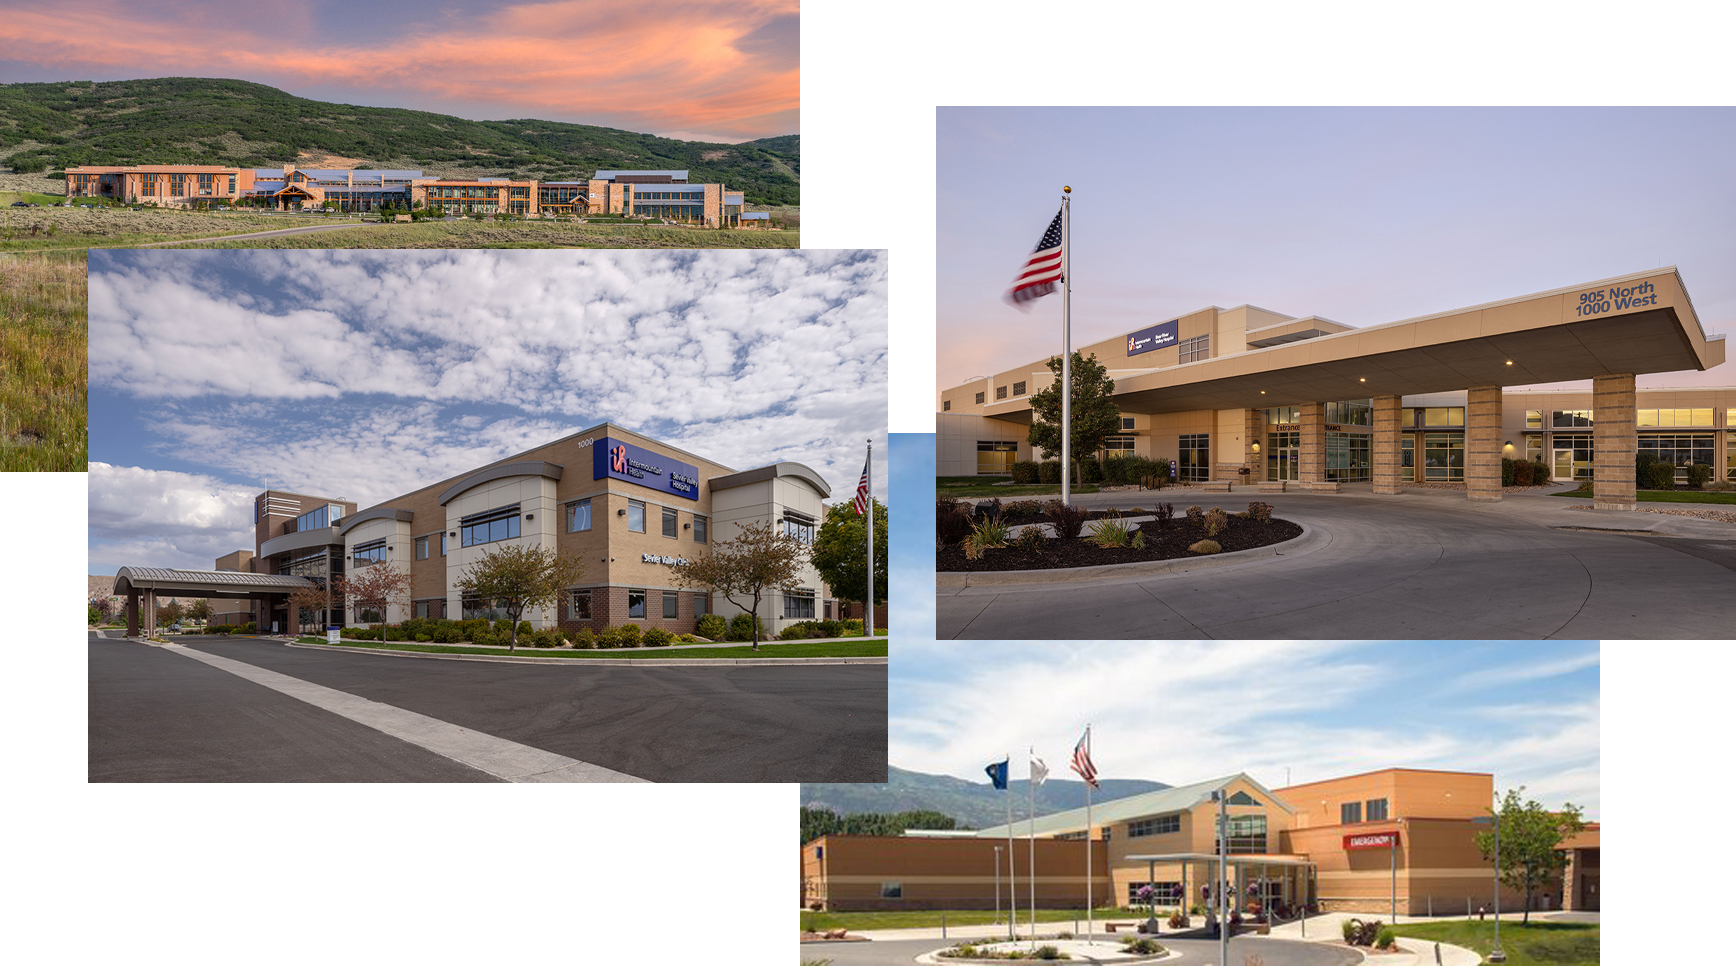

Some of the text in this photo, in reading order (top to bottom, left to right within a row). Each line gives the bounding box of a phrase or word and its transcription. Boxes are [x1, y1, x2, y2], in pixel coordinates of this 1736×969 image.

[1580, 281, 1654, 305] 905 North
[1576, 293, 1657, 317] 1000 West
[577, 437, 594, 449] 1000
[628, 457, 663, 476] Intermountain
[628, 466, 645, 480] Health
[672, 471, 698, 488] Sevier Valley
[672, 480, 690, 492] Hospital
[641, 553, 661, 564] Sevier
[661, 555, 678, 567] Valley
